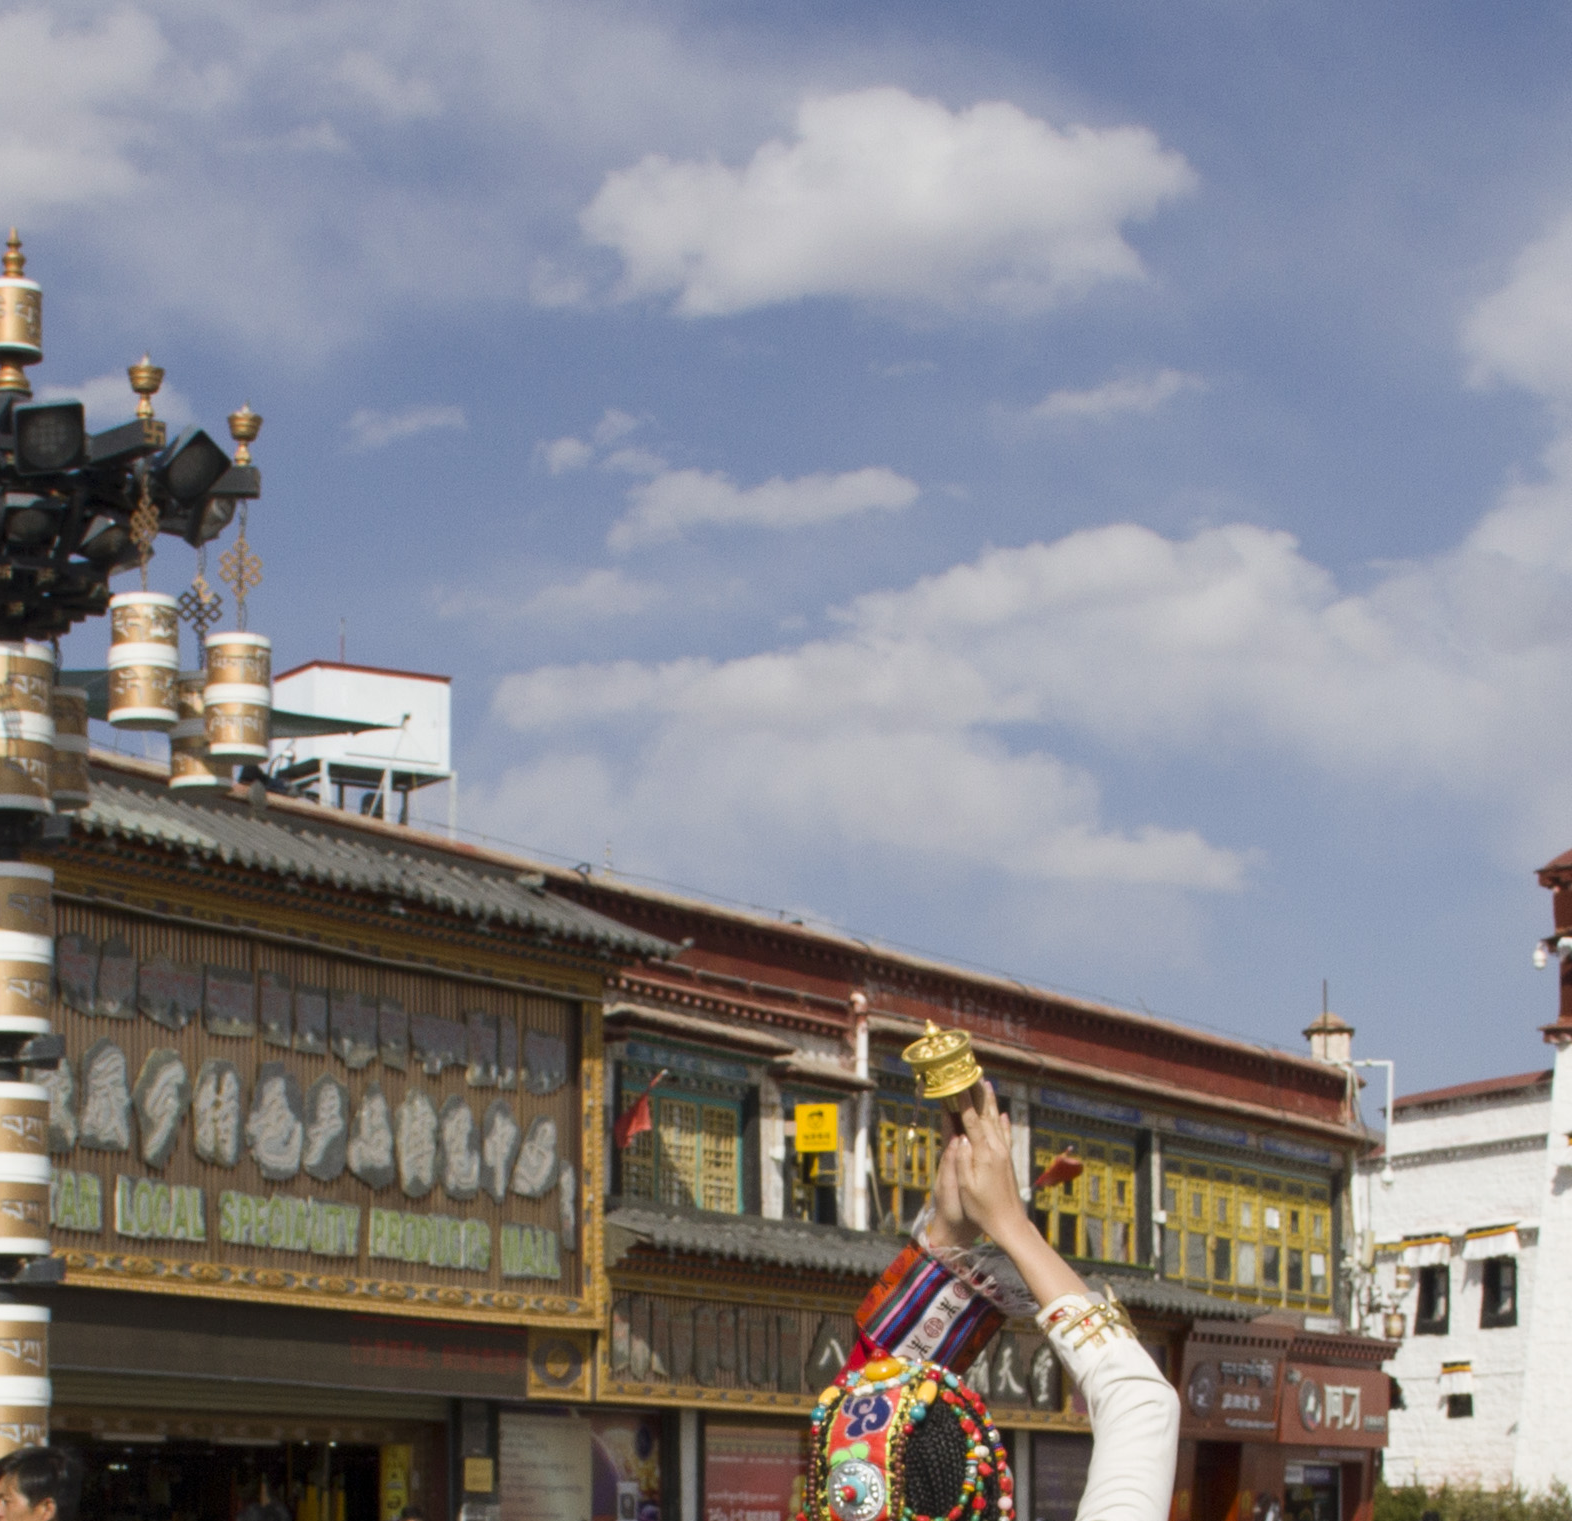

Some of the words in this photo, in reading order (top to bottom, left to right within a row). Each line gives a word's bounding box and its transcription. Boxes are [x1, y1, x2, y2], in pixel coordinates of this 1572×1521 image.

[118, 1176, 205, 1239] LOCAL
[369, 1208, 491, 1271] PRODUCTS
[501, 1223, 560, 1278] MALL
